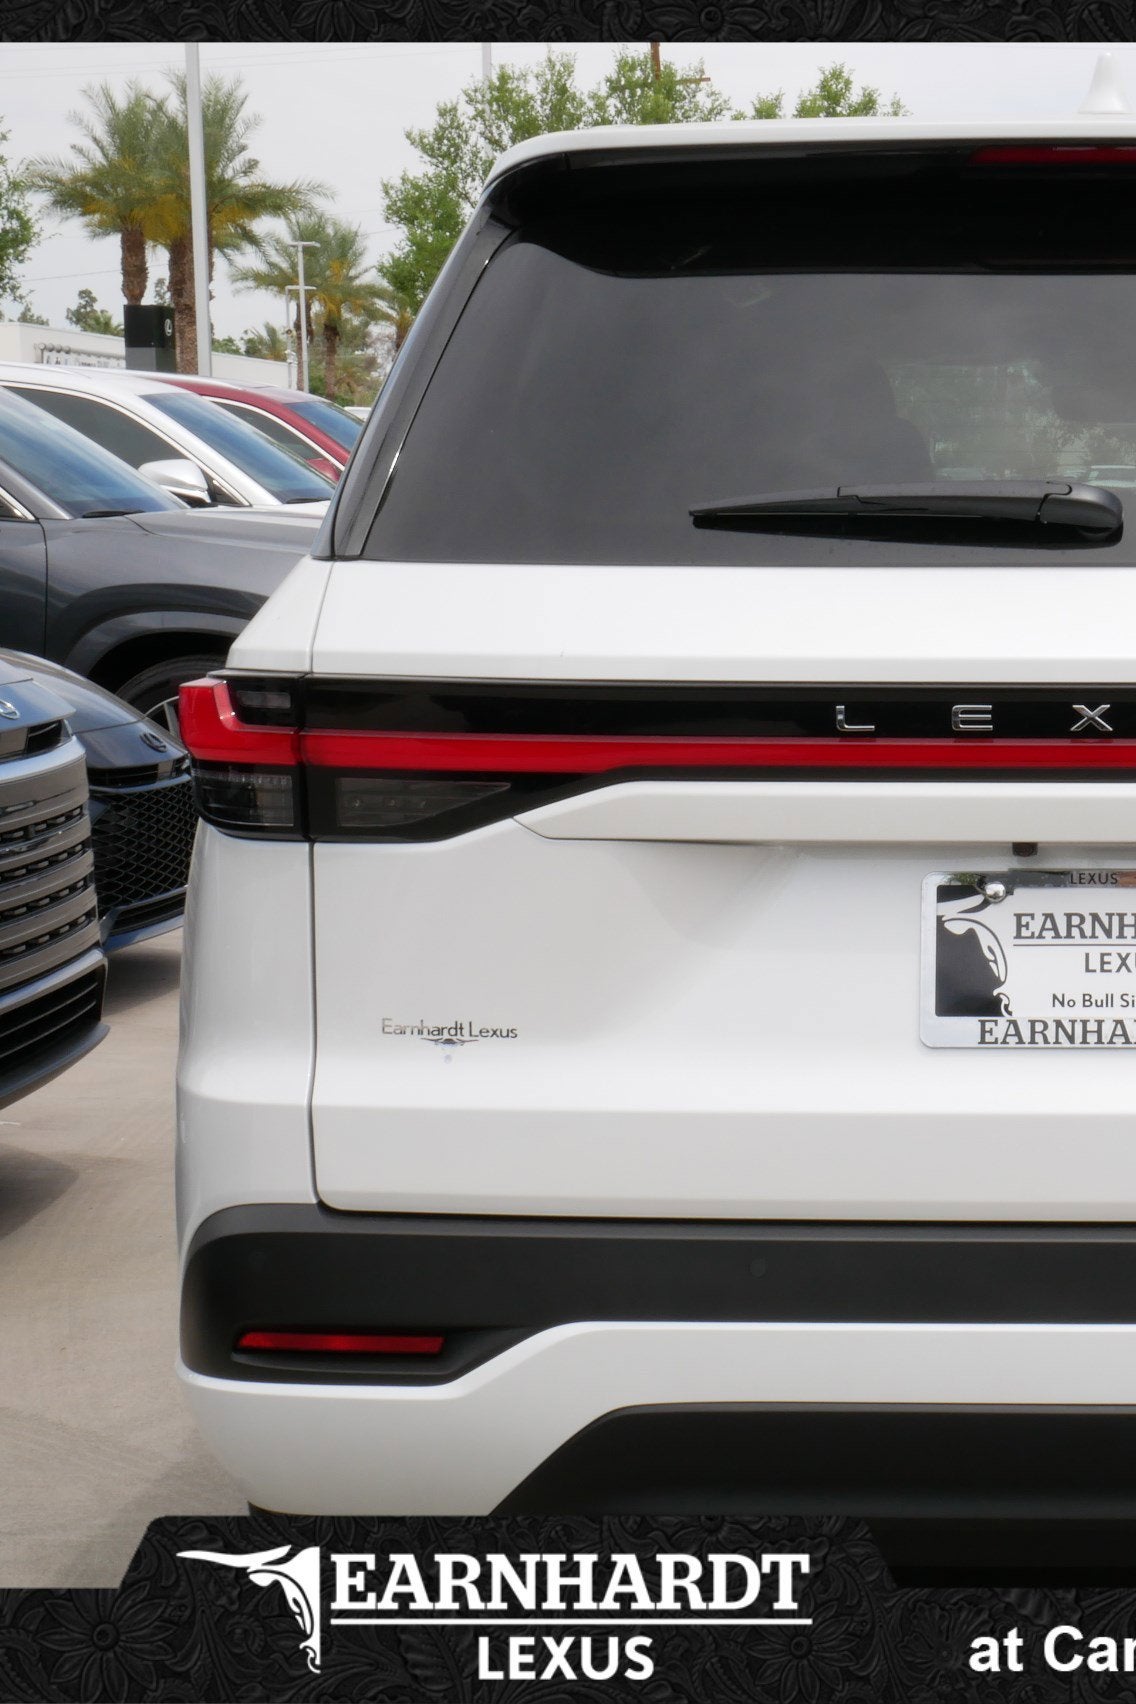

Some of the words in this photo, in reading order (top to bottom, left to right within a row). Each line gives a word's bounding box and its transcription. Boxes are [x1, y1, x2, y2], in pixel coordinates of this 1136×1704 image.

[1069, 872, 1118, 885] LEXUS
[1051, 993, 1076, 1009] No
[1081, 993, 1115, 1009] Bull
[381, 1017, 465, 1038] Earnhardt
[468, 1021, 518, 1039] Lexus
